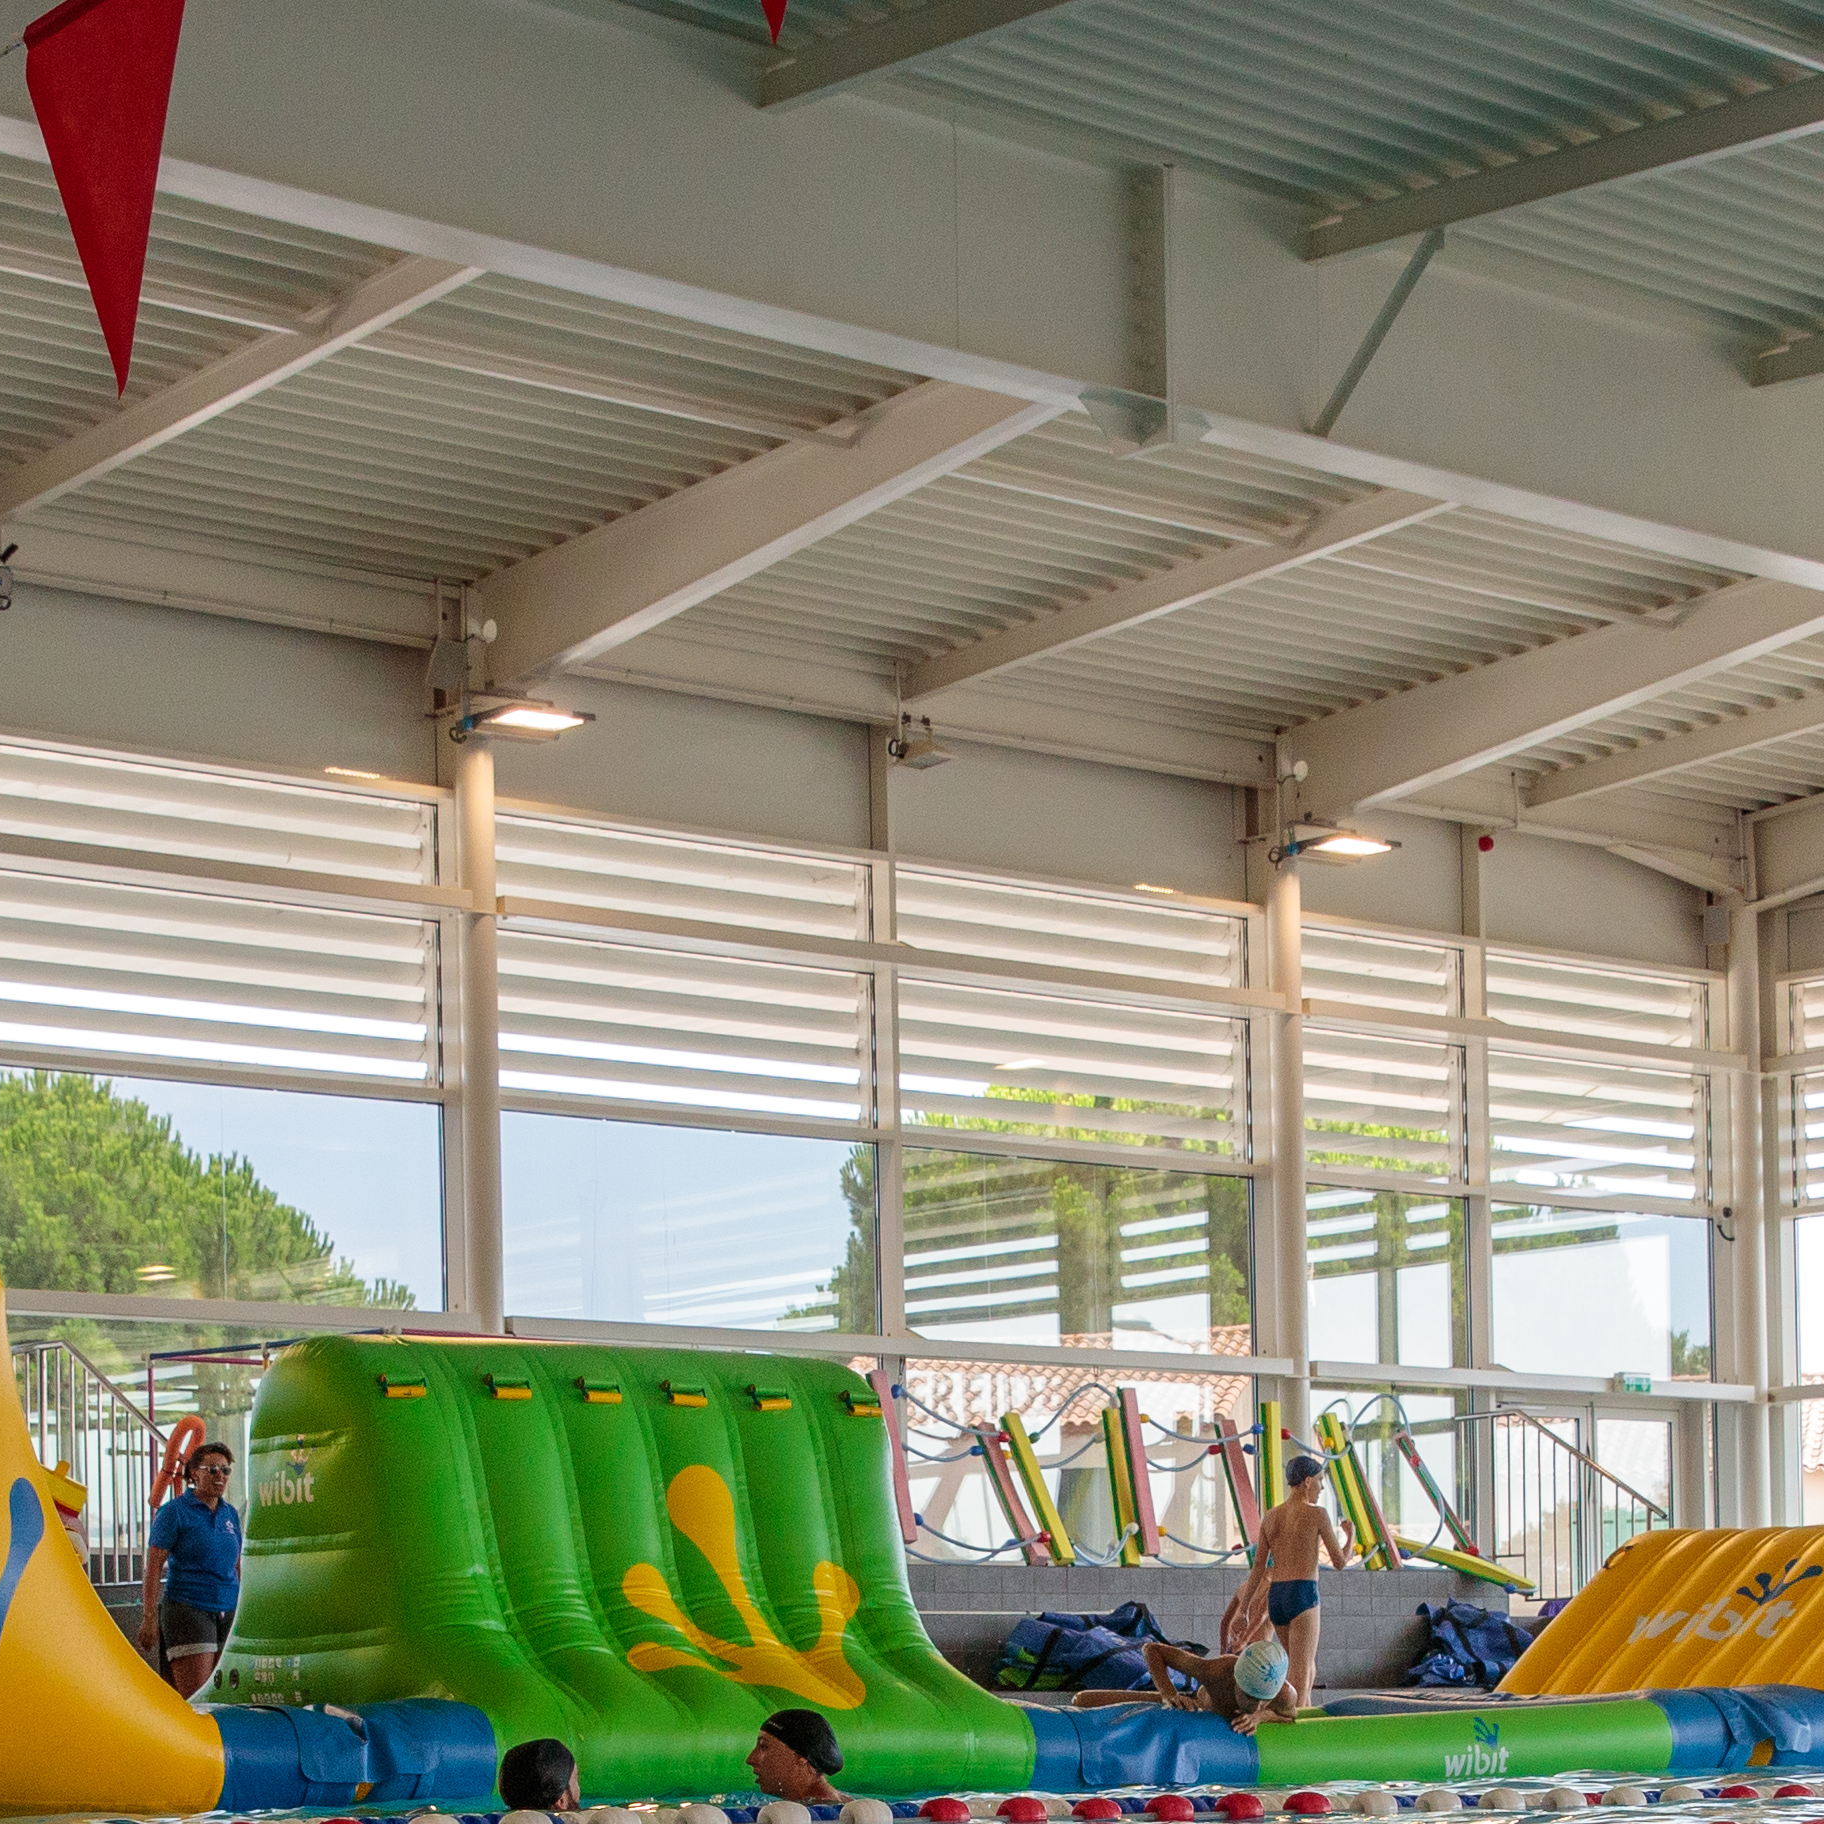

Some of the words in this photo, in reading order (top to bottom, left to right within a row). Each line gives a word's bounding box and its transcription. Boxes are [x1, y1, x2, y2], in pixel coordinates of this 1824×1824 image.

[259, 1471, 315, 1506] wibit
[1627, 1597, 1796, 1644] wibit
[1444, 1744, 1510, 1777] wibit
